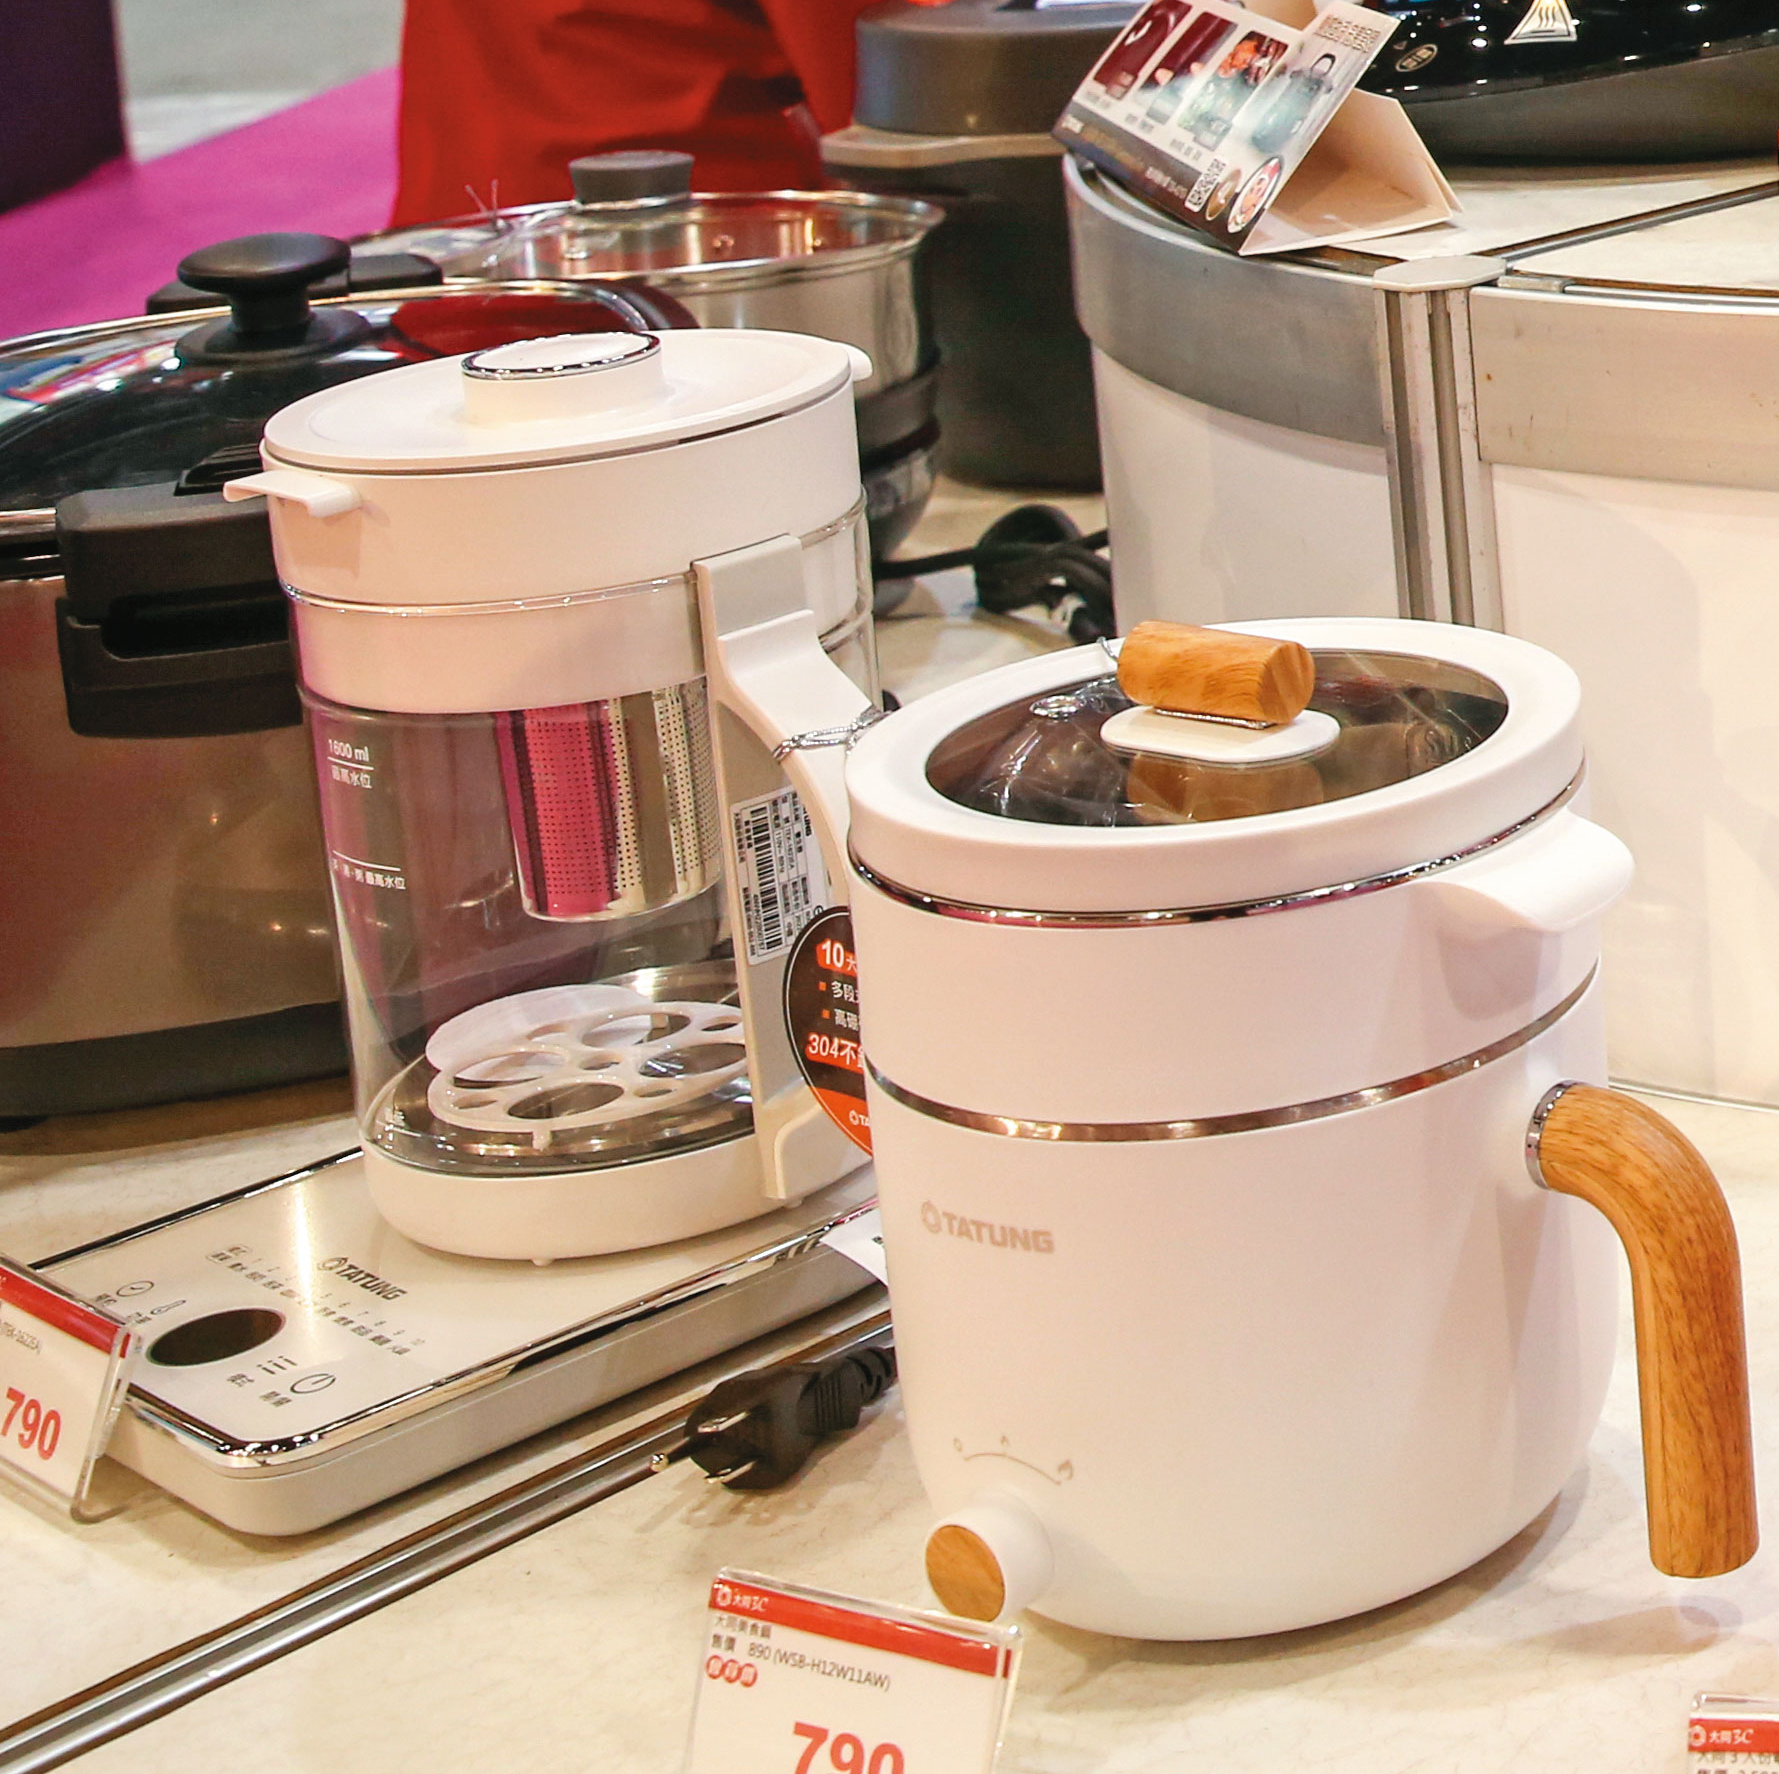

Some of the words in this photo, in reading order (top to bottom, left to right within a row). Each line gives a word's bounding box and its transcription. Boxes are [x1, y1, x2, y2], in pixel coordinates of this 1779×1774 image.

[328, 739, 353, 758] 1600
[354, 746, 370, 762] ml
[941, 1211, 1055, 1253] TATUNG
[336, 1263, 409, 1302] TATUNG
[748, 1642, 772, 1661] 890
